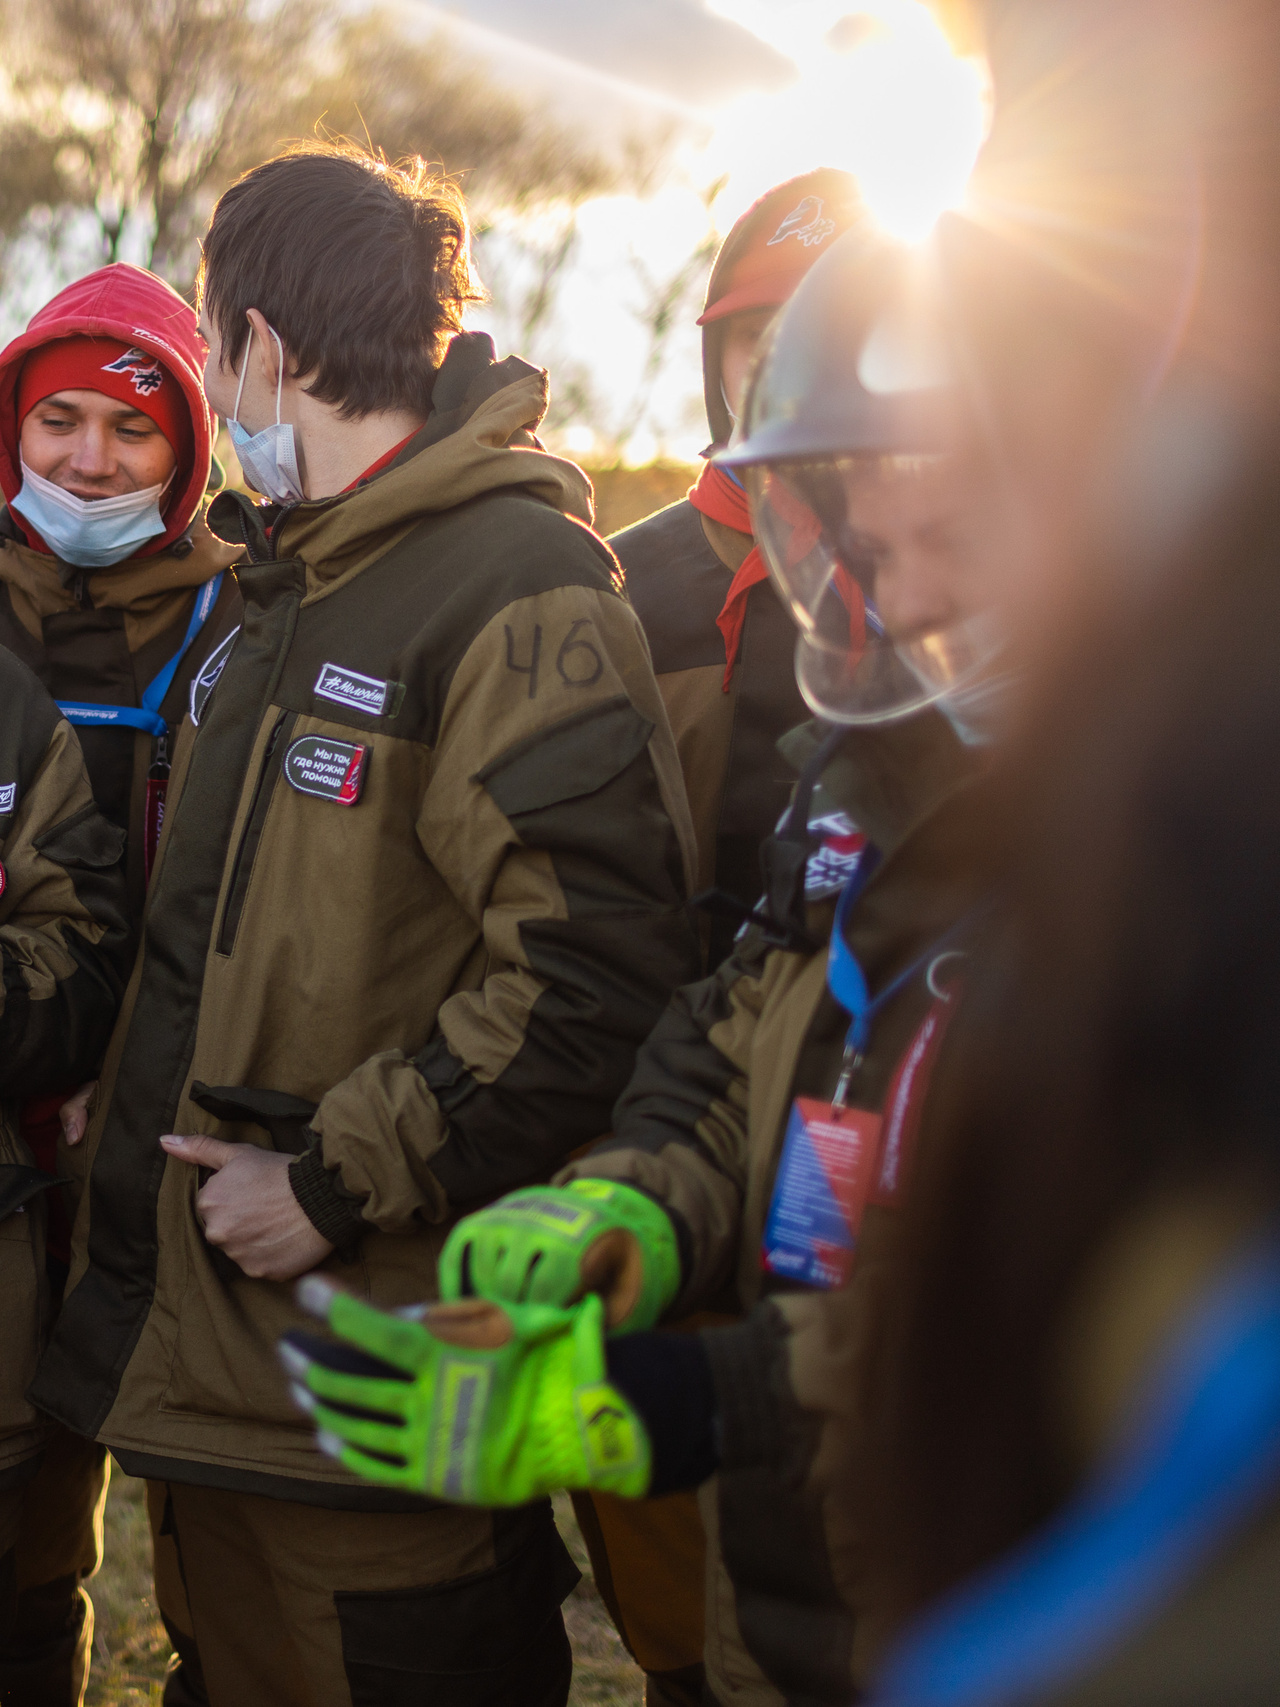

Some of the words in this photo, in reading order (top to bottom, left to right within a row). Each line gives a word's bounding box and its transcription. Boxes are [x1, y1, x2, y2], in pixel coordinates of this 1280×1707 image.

[504, 617, 604, 699] 46
[314, 748, 332, 760] Мы
[293, 756, 312, 768] где
[301, 770, 342, 788] помощь
